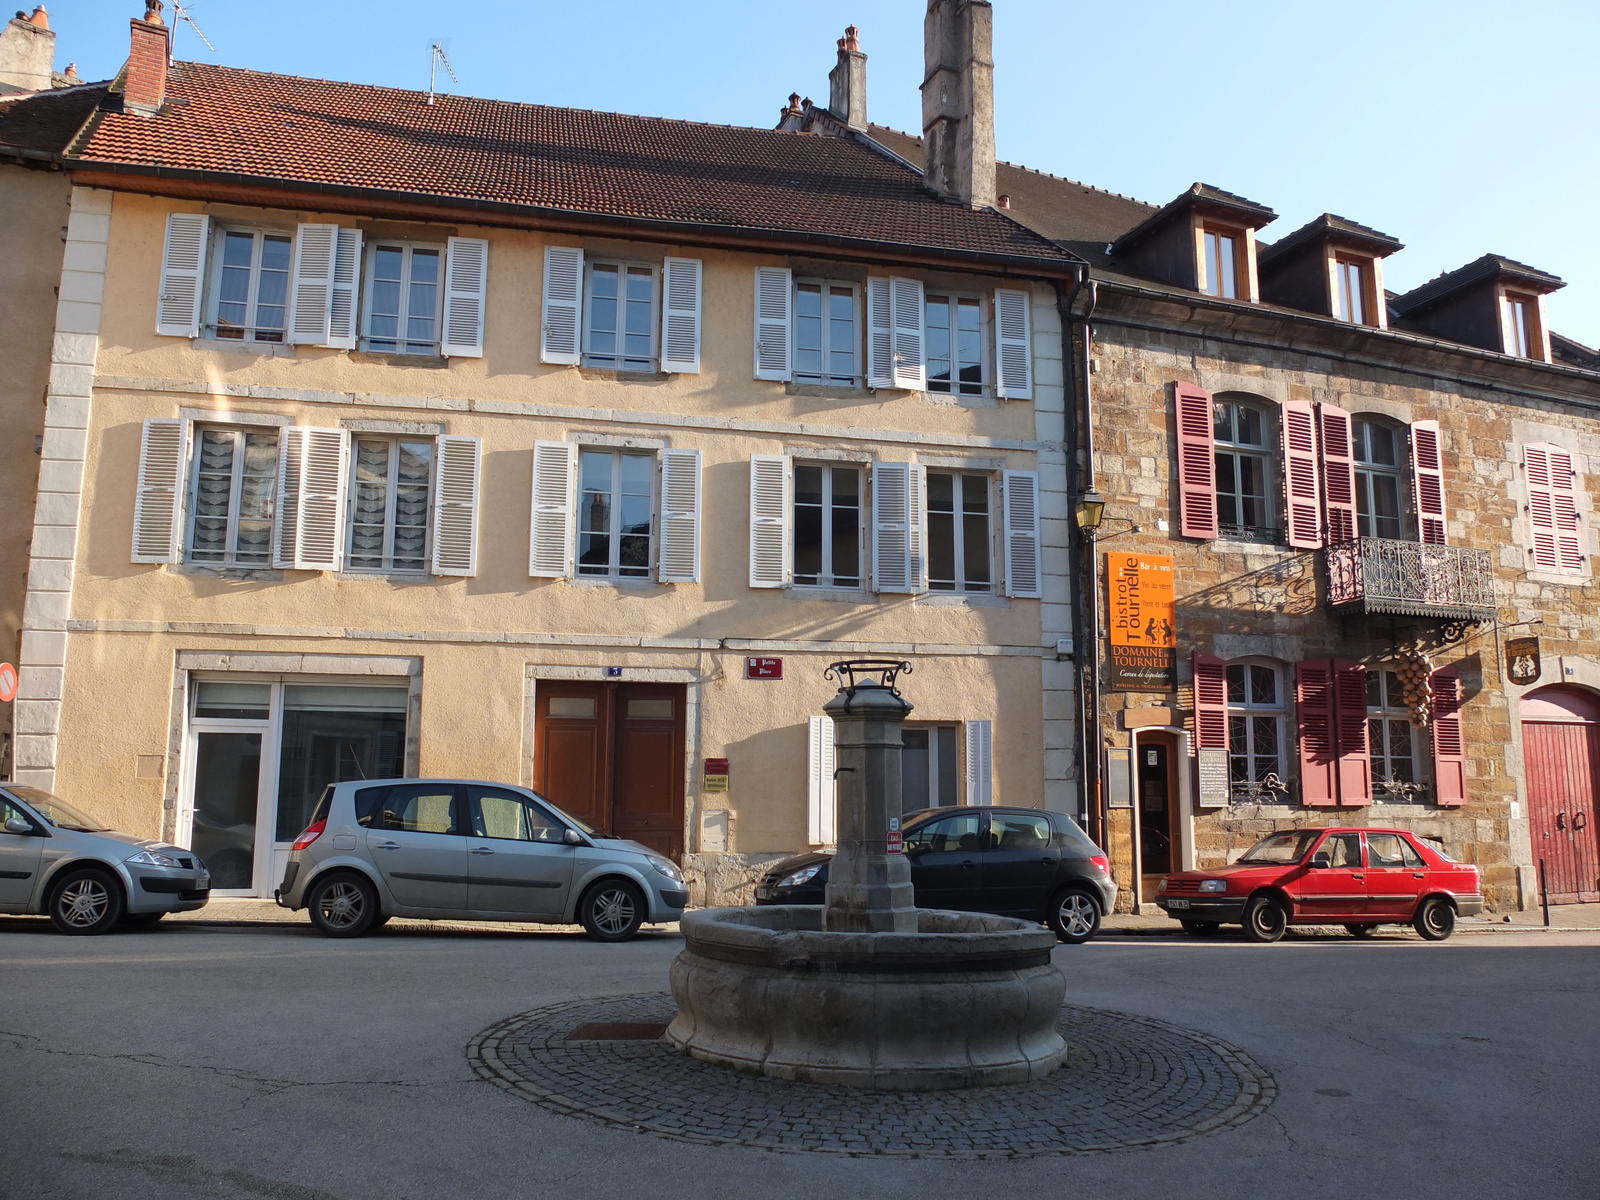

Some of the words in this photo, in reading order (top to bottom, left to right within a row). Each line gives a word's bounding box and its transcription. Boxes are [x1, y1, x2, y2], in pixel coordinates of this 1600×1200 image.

[1140, 562, 1150, 570] Bar
[1153, 562, 1158, 571] à
[1160, 564, 1171, 572] vins
[1116, 577, 1128, 629] bistrot
[1124, 557, 1141, 643] Tournelle
[1113, 646, 1163, 657] DOMAINE
[1113, 656, 1175, 668] TOURNELLE
